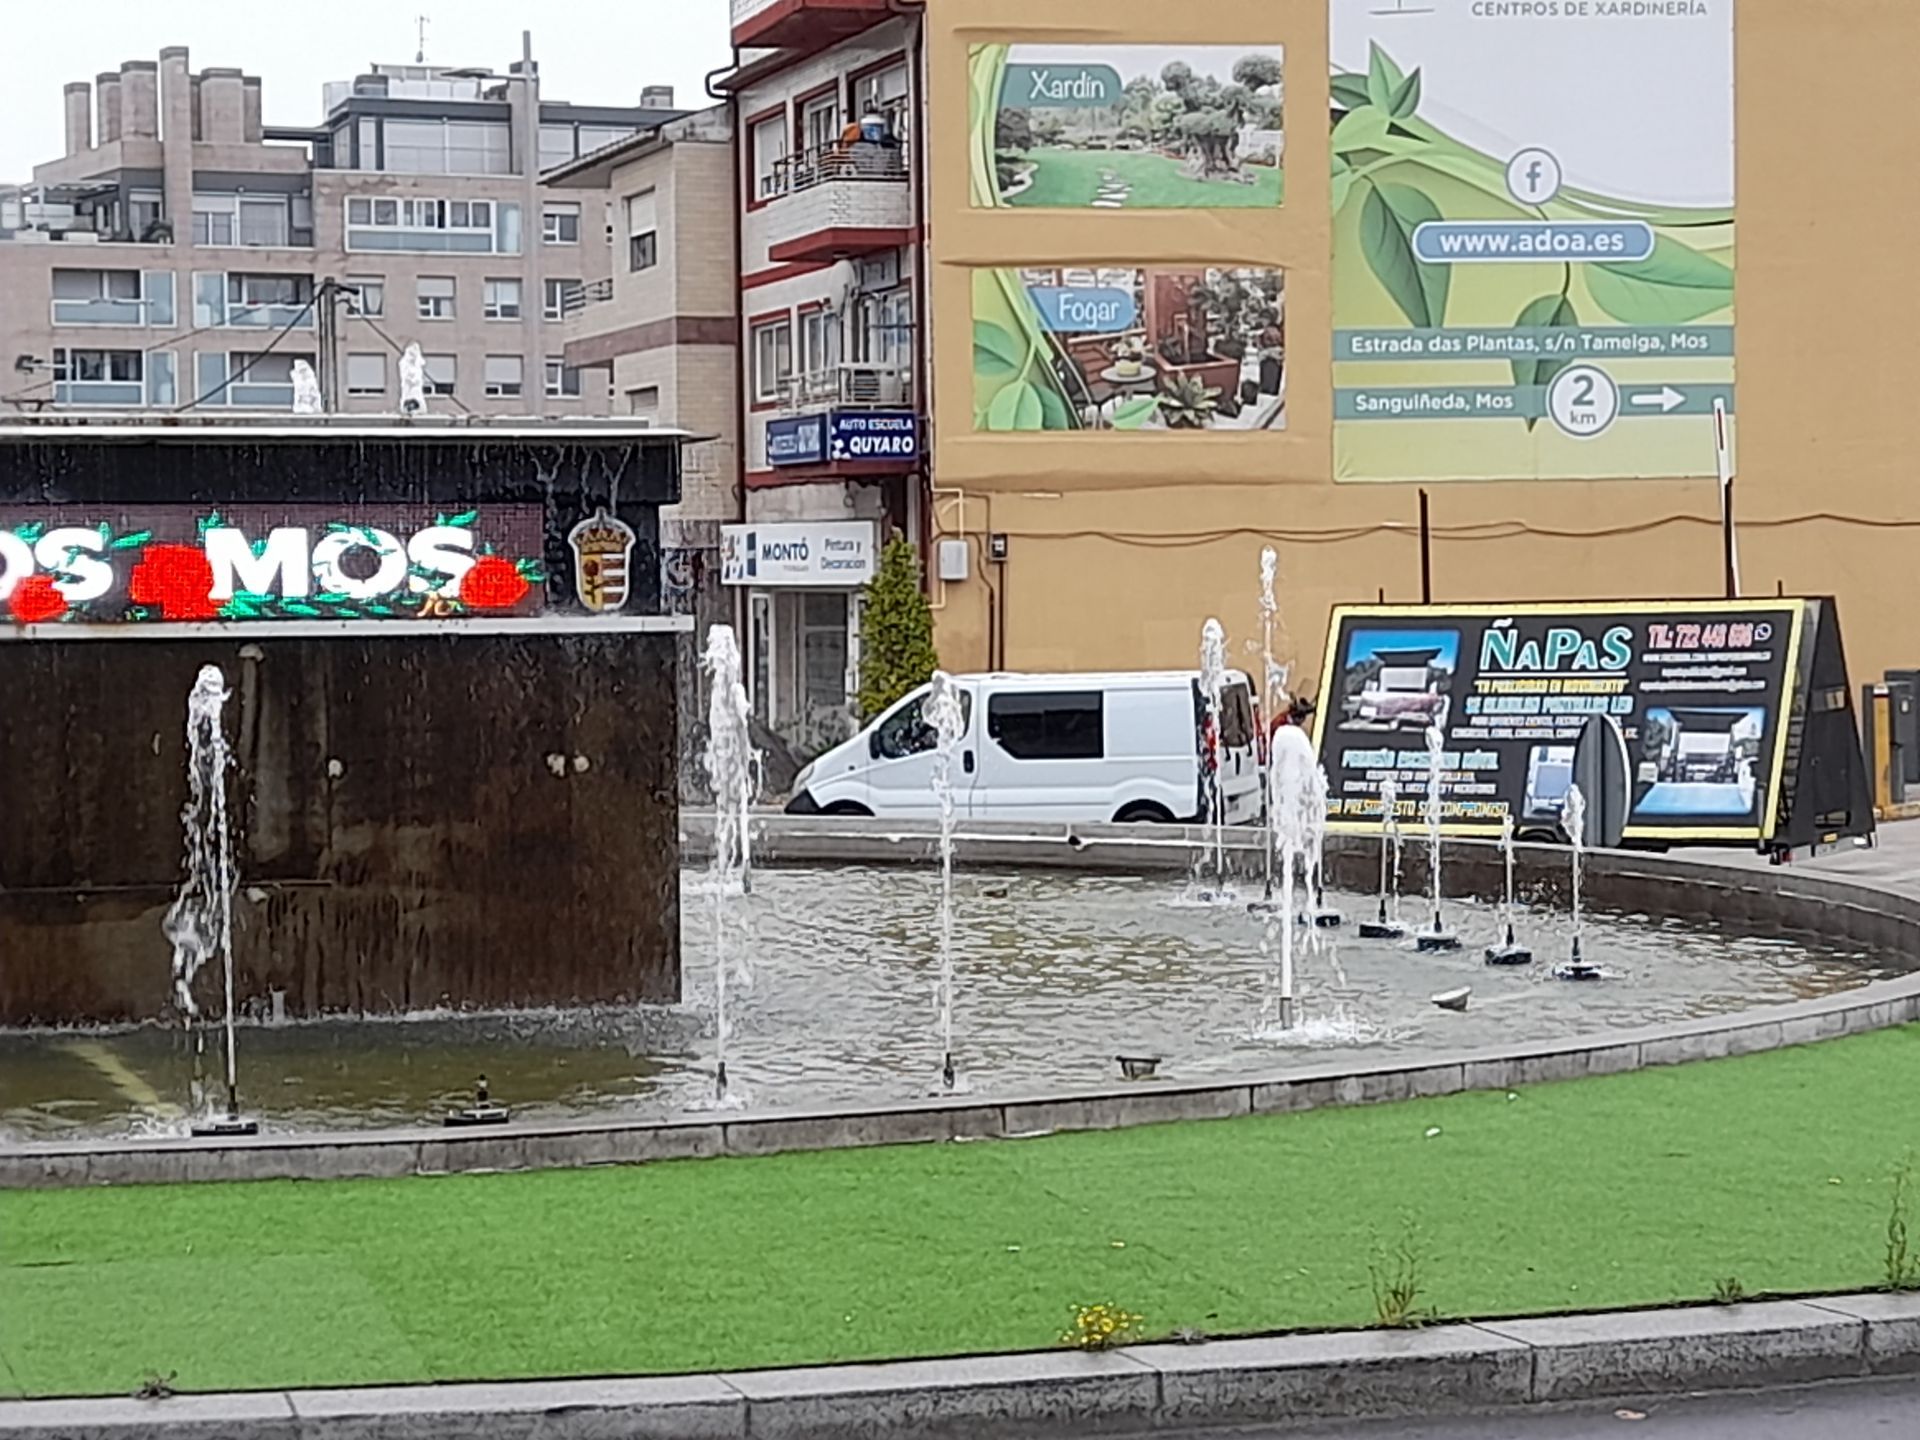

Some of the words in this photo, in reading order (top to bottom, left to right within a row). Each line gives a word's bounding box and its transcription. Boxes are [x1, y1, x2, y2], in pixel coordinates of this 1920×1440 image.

[1472, 1, 1558, 17] CENTROS
[1565, 1, 1589, 16] DE
[1595, 0, 1708, 16] XARDINERÍA
[1441, 229, 1625, 254] www.adoa.es
[1058, 294, 1120, 327] Fogar
[1351, 337, 1423, 354] Estrada
[1428, 336, 1461, 353] das
[1467, 334, 1540, 353] Plantas,
[1545, 333, 1575, 352] s/n
[1581, 332, 1666, 352] Tameiga,
[1671, 332, 1708, 349] Mos
[1571, 374, 1595, 407] 2
[1355, 394, 1471, 413] Sanguiñeda,
[1476, 393, 1513, 410] Mos
[839, 419, 867, 430] AUTO
[868, 419, 913, 430] ESCUELA
[1569, 410, 1597, 426] km
[849, 436, 914, 454] QUYARO
[762, 536, 809, 561] MONTÓ
[205, 525, 476, 600] MOS
